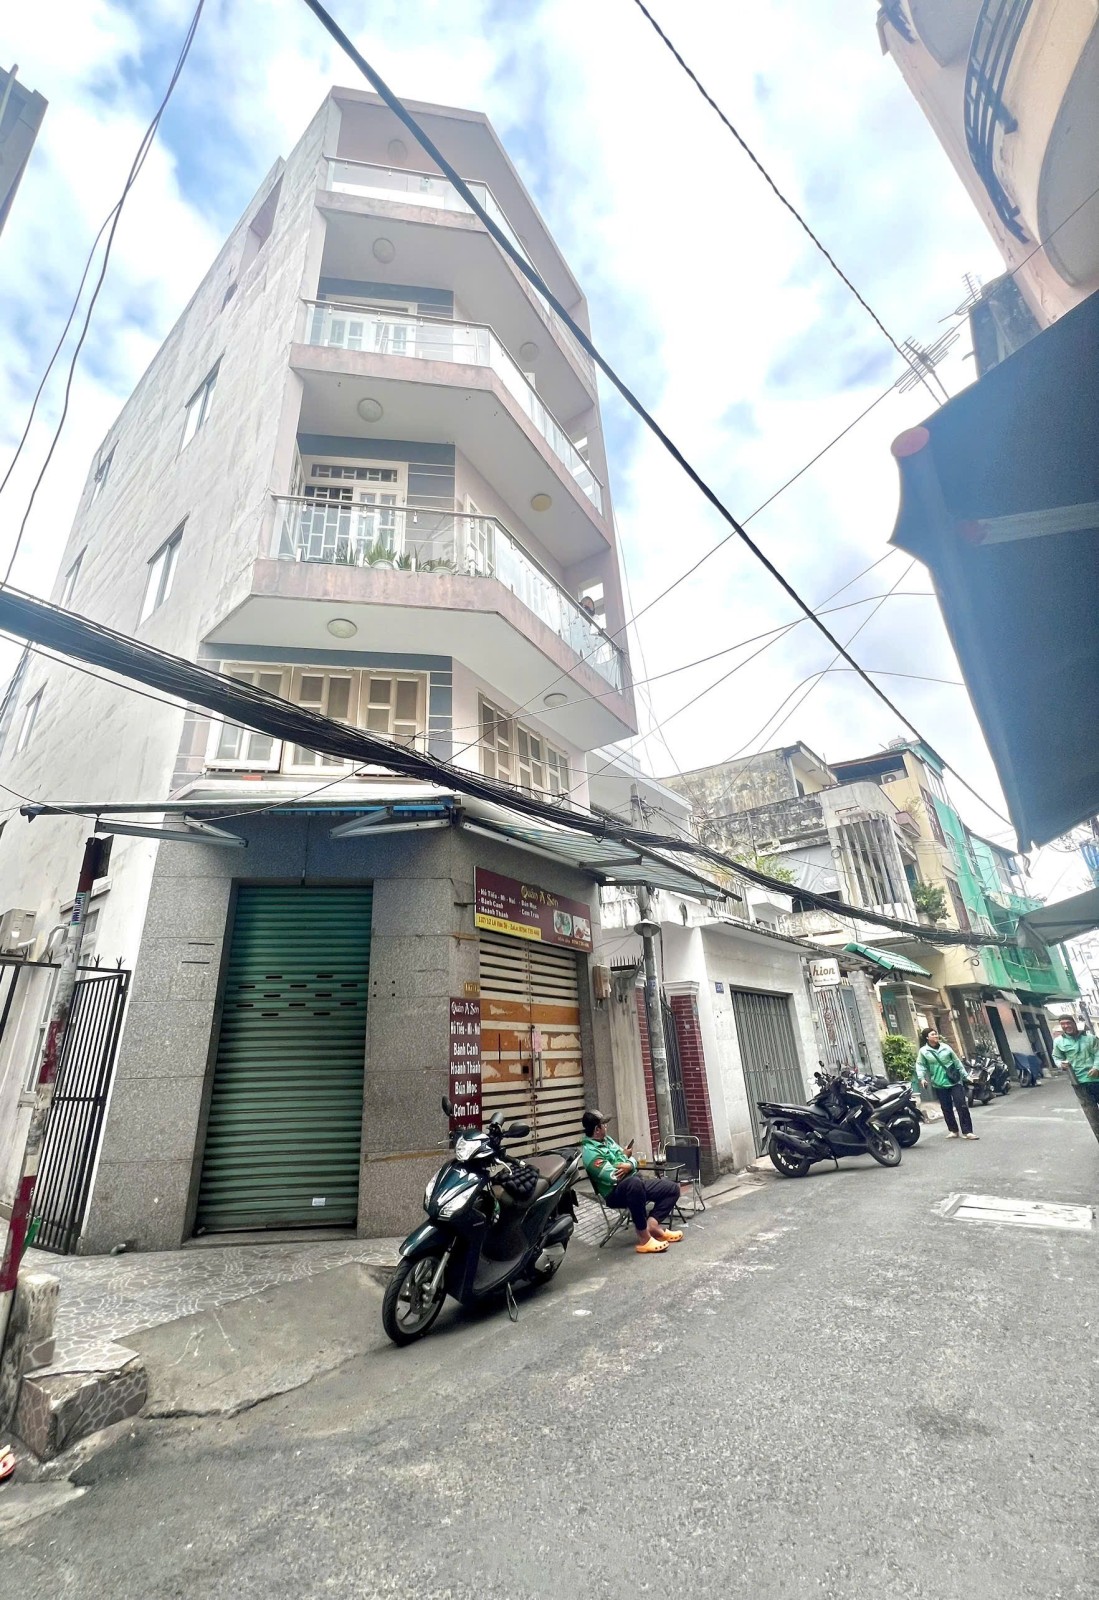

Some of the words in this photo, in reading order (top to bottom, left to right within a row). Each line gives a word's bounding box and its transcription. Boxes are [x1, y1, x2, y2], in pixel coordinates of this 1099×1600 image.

[451, 1001, 464, 1015] Quán
[454, 1042, 466, 1055] Bánh
[467, 1042, 478, 1055] Canh
[467, 1060, 480, 1073] Thánh
[455, 1081, 465, 1095] Bún
[454, 1103, 465, 1117] Cơm
[466, 1102, 479, 1116] Trưa
